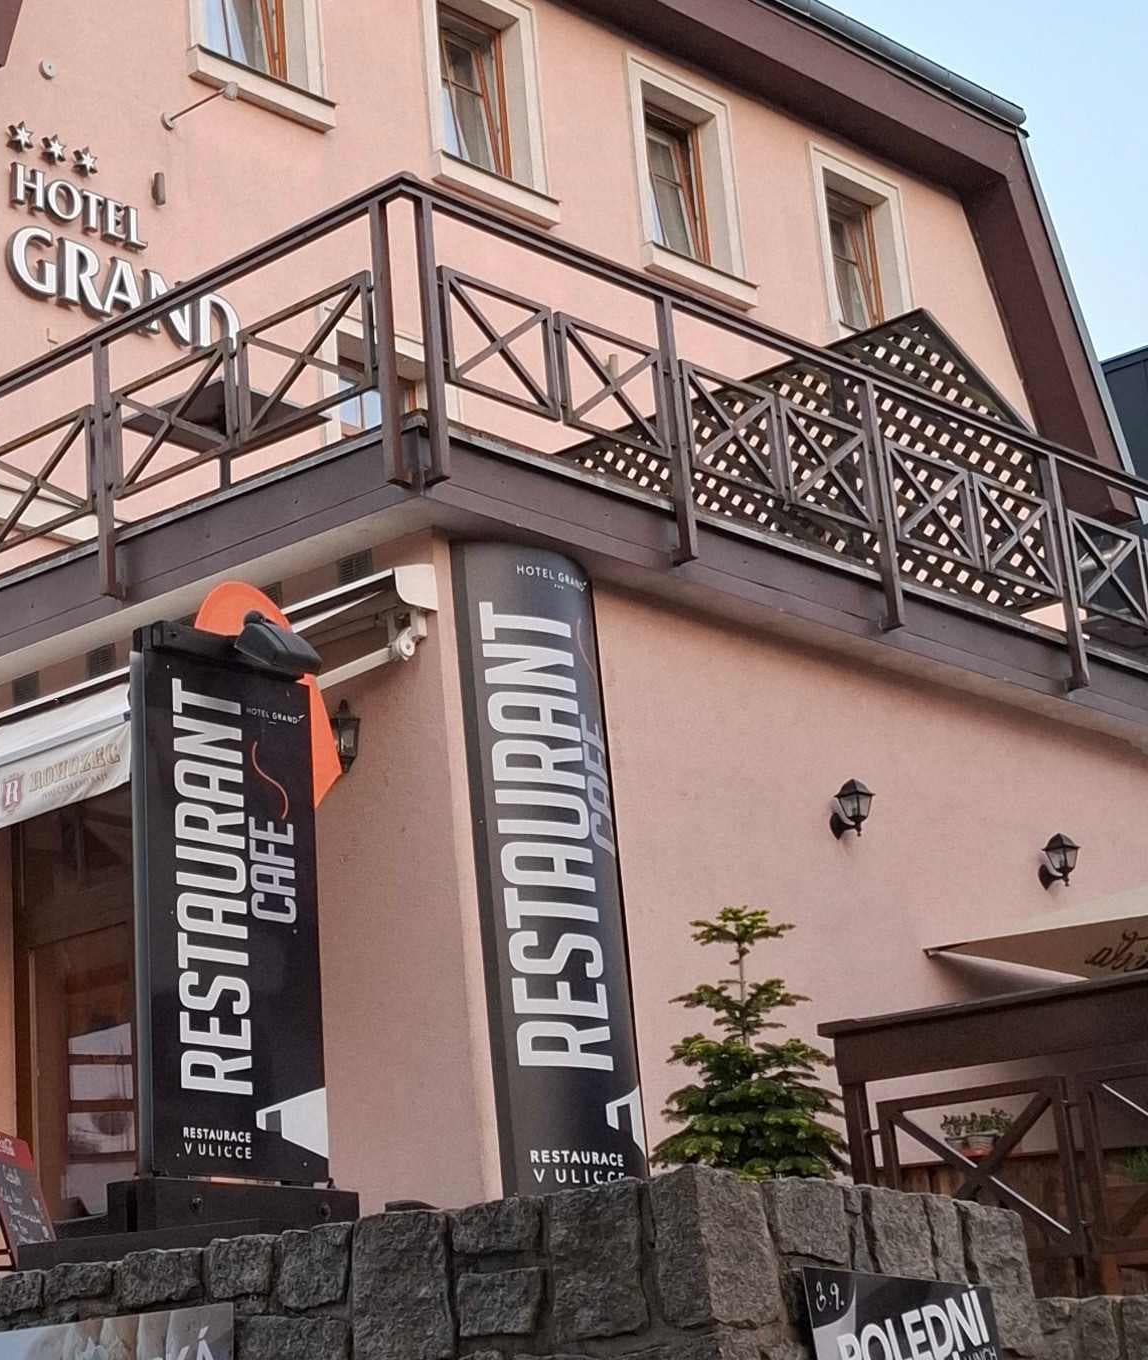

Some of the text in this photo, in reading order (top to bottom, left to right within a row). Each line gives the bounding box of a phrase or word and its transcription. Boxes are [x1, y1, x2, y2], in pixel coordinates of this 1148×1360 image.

[10, 162, 148, 251] HOTEL
[6, 225, 241, 355] GRAND
[516, 564, 555, 580] HOTEL
[478, 601, 614, 1071] RESTAURANT
[172, 678, 254, 1095] RESTAURANT
[248, 816, 298, 925] CAFE
[183, 1127, 252, 1143] RESTAURACE
[184, 1142, 192, 1155] V
[530, 1150, 624, 1167] RESTAURACE
[533, 1168, 545, 1184] V
